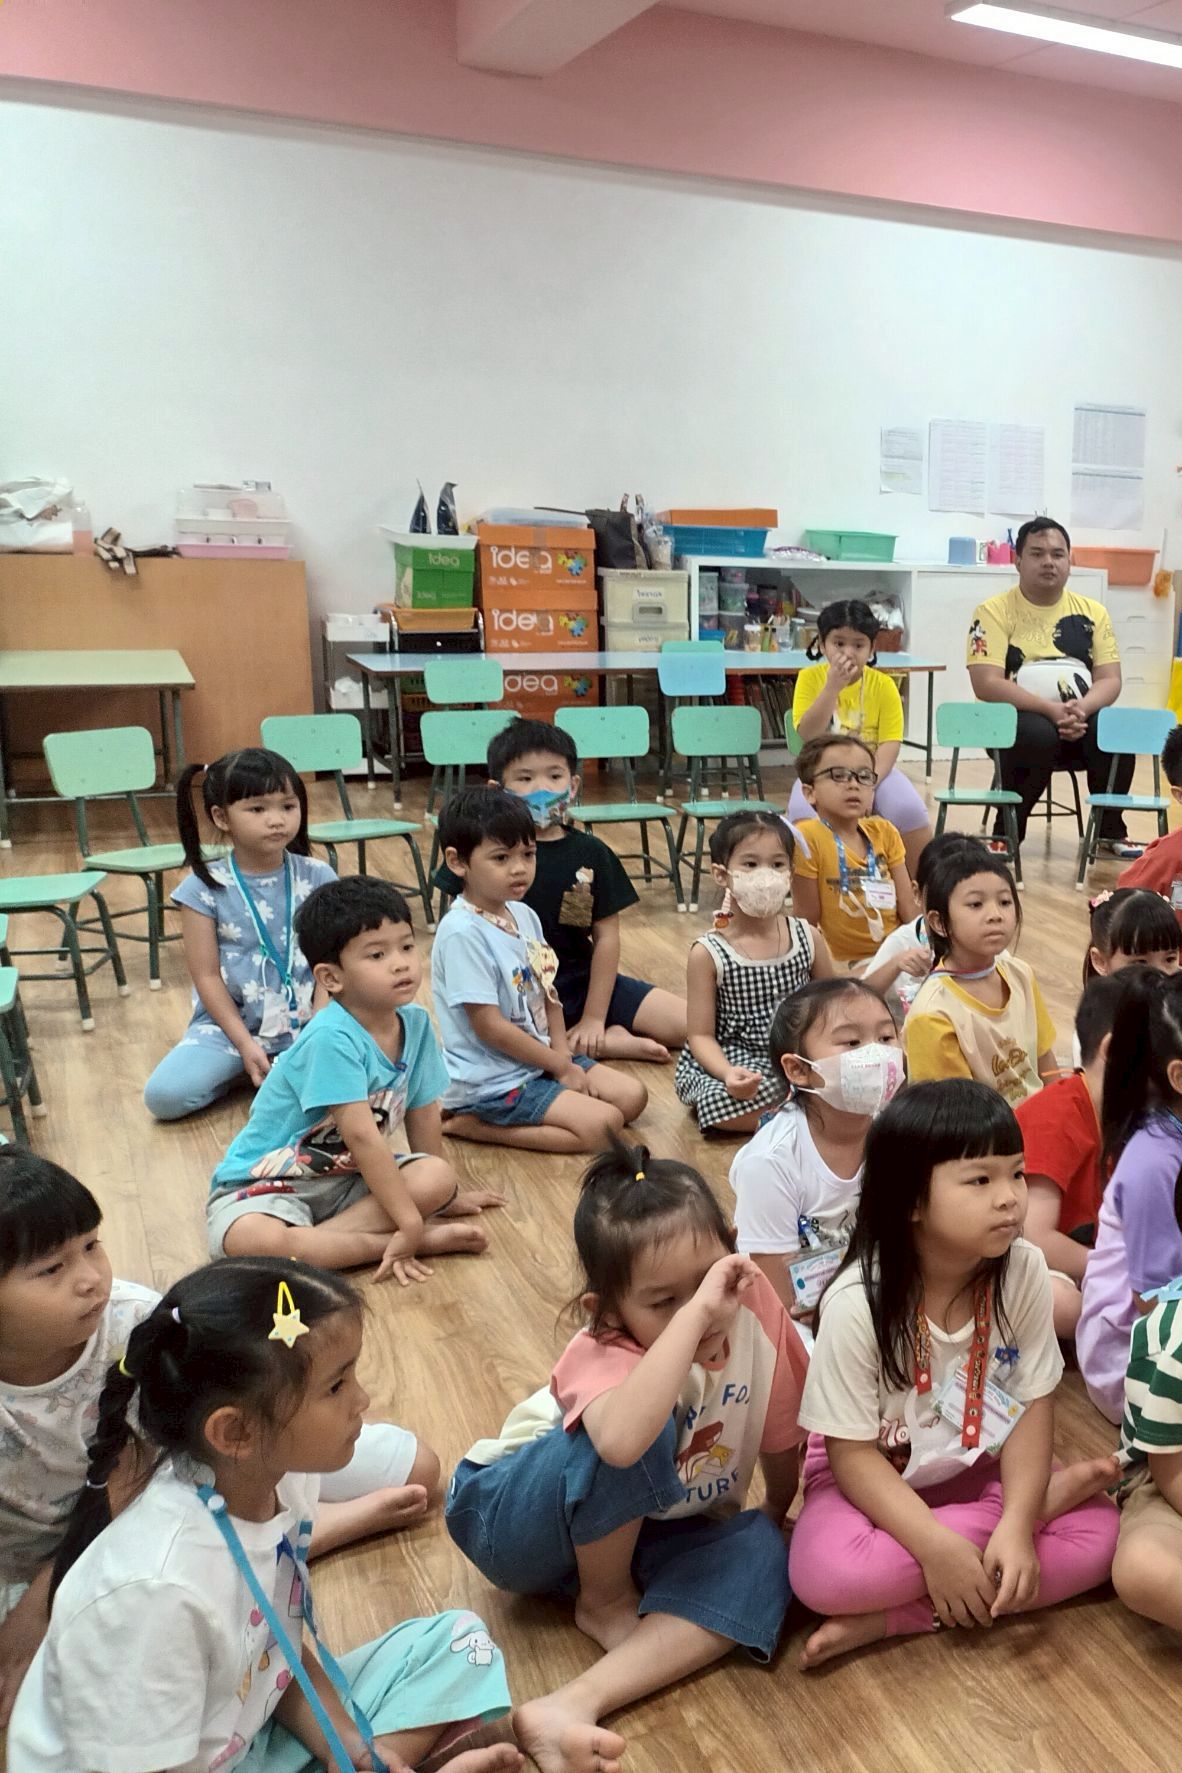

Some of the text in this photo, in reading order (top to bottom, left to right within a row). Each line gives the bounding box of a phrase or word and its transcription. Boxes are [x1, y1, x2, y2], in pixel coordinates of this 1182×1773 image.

[428, 552, 460, 569] idea
[490, 545, 553, 570] idea
[504, 673, 559, 692] dea
